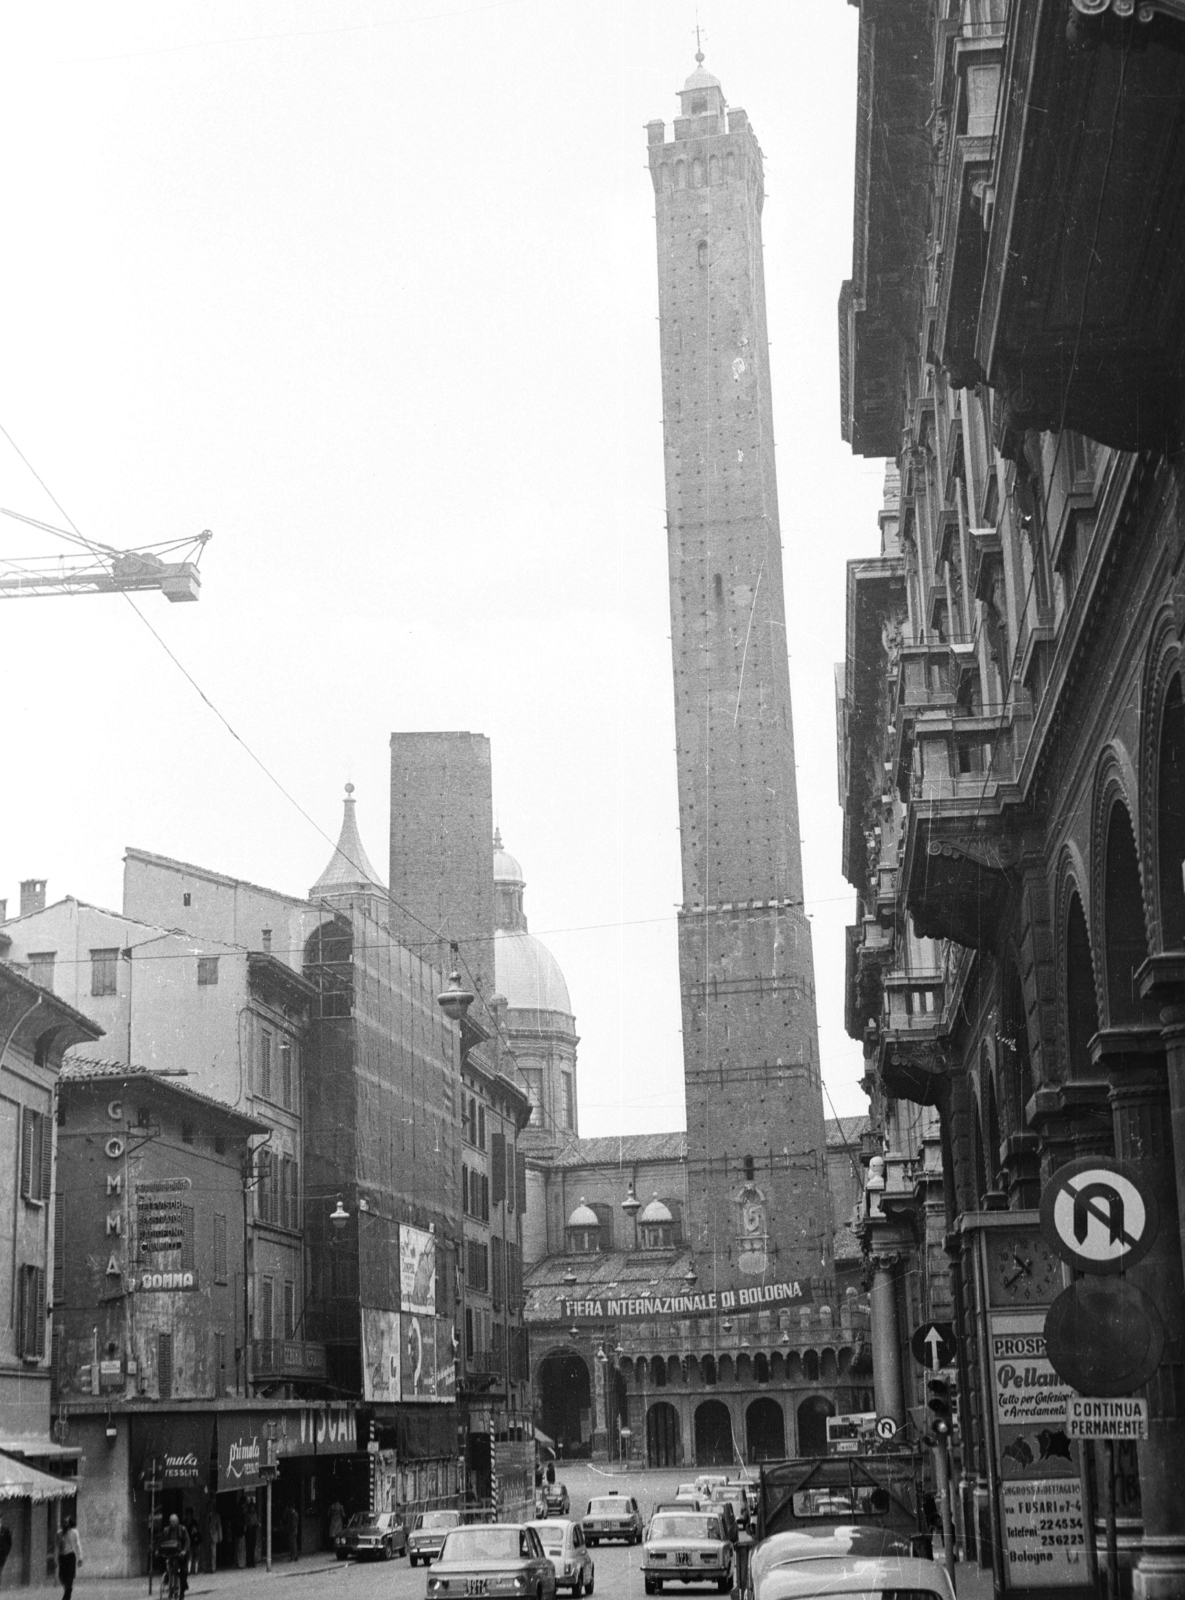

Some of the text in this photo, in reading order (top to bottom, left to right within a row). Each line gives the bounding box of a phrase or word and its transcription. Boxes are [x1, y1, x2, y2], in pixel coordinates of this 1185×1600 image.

[104, 1100, 124, 1275] GOMMA
[565, 1299, 603, 1317] FIERA
[607, 1293, 717, 1316] INTERNAZIONALE
[721, 1290, 736, 1308] DI
[739, 1282, 803, 1305] BOLOGNA
[994, 1338, 1045, 1355] PROSP
[997, 1364, 1067, 1389] Pellam
[998, 1392, 1019, 1407] Tutto
[1020, 1395, 1035, 1407] per
[1004, 1405, 1067, 1418] e Arredamento
[1073, 1402, 1142, 1417] CONTINUA
[1071, 1420, 1144, 1435] PERMANENTE
[1018, 1501, 1057, 1514] FUSARI
[1040, 1518, 1083, 1530] 224534
[1041, 1534, 1085, 1546] 236223
[1009, 1550, 1053, 1565] Bologna
